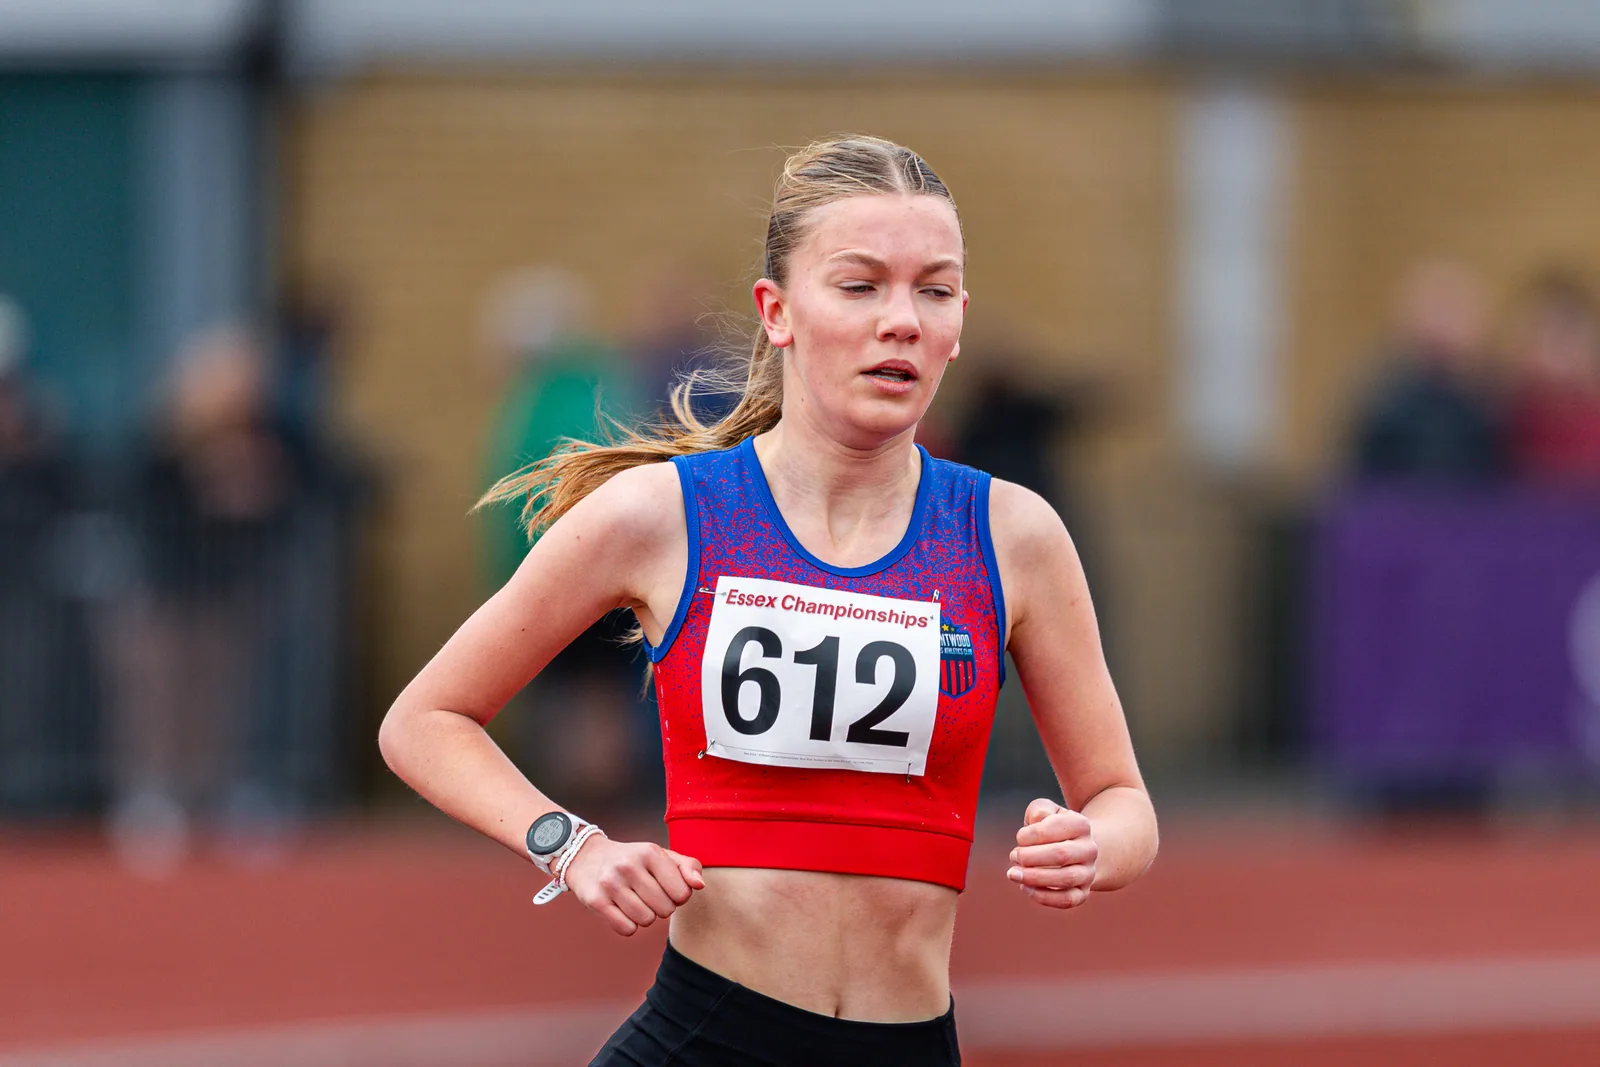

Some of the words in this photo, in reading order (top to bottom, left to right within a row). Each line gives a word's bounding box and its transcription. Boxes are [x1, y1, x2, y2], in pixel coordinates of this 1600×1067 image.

[725, 588, 777, 609] Essex
[781, 594, 928, 628] Championships
[721, 625, 917, 747] 612
